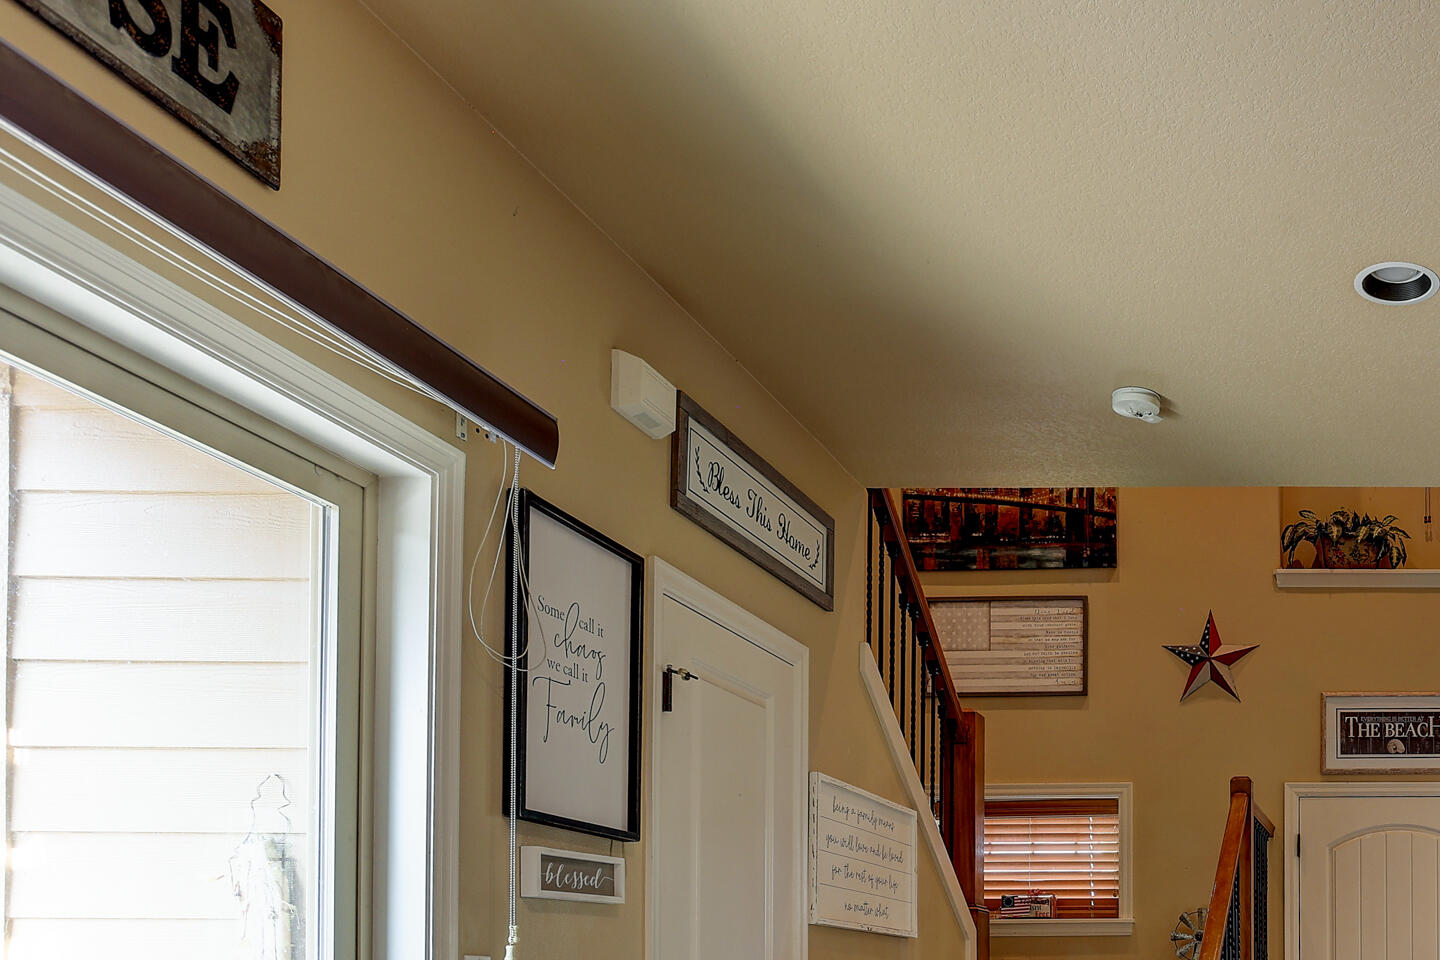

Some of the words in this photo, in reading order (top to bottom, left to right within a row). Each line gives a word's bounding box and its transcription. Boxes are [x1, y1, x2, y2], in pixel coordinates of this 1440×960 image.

[707, 461, 742, 510] Bless
[746, 488, 773, 532] This
[776, 512, 811, 561] Home
[537, 594, 565, 622] Some
[578, 617, 595, 634] call
[597, 623, 604, 638] it
[553, 602, 606, 680] chaos
[546, 658, 561, 672] we
[562, 663, 579, 680] call
[582, 668, 589, 682] it
[532, 676, 615, 764] Family
[1345, 716, 1381, 738] THE
[543, 862, 610, 890] blessed
